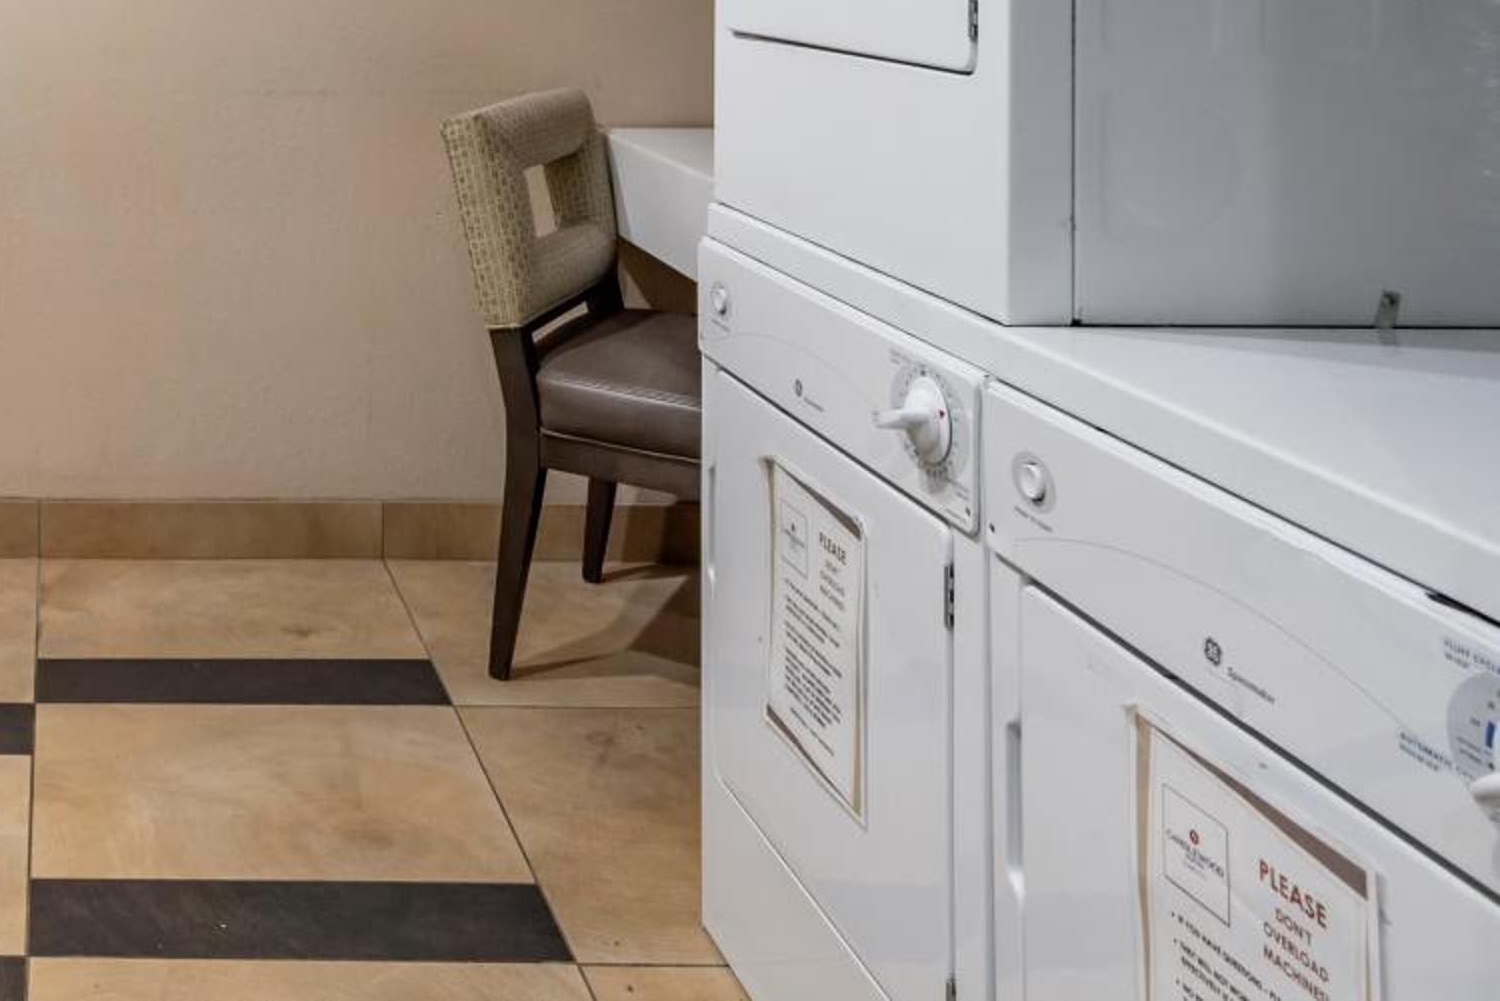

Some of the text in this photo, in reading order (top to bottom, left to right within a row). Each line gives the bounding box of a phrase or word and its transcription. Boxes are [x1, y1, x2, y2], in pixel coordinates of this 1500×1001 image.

[1259, 859, 1327, 929] PLEASE
[1263, 921, 1329, 982] OVERLOAD
[1275, 908, 1313, 945] DON'T
